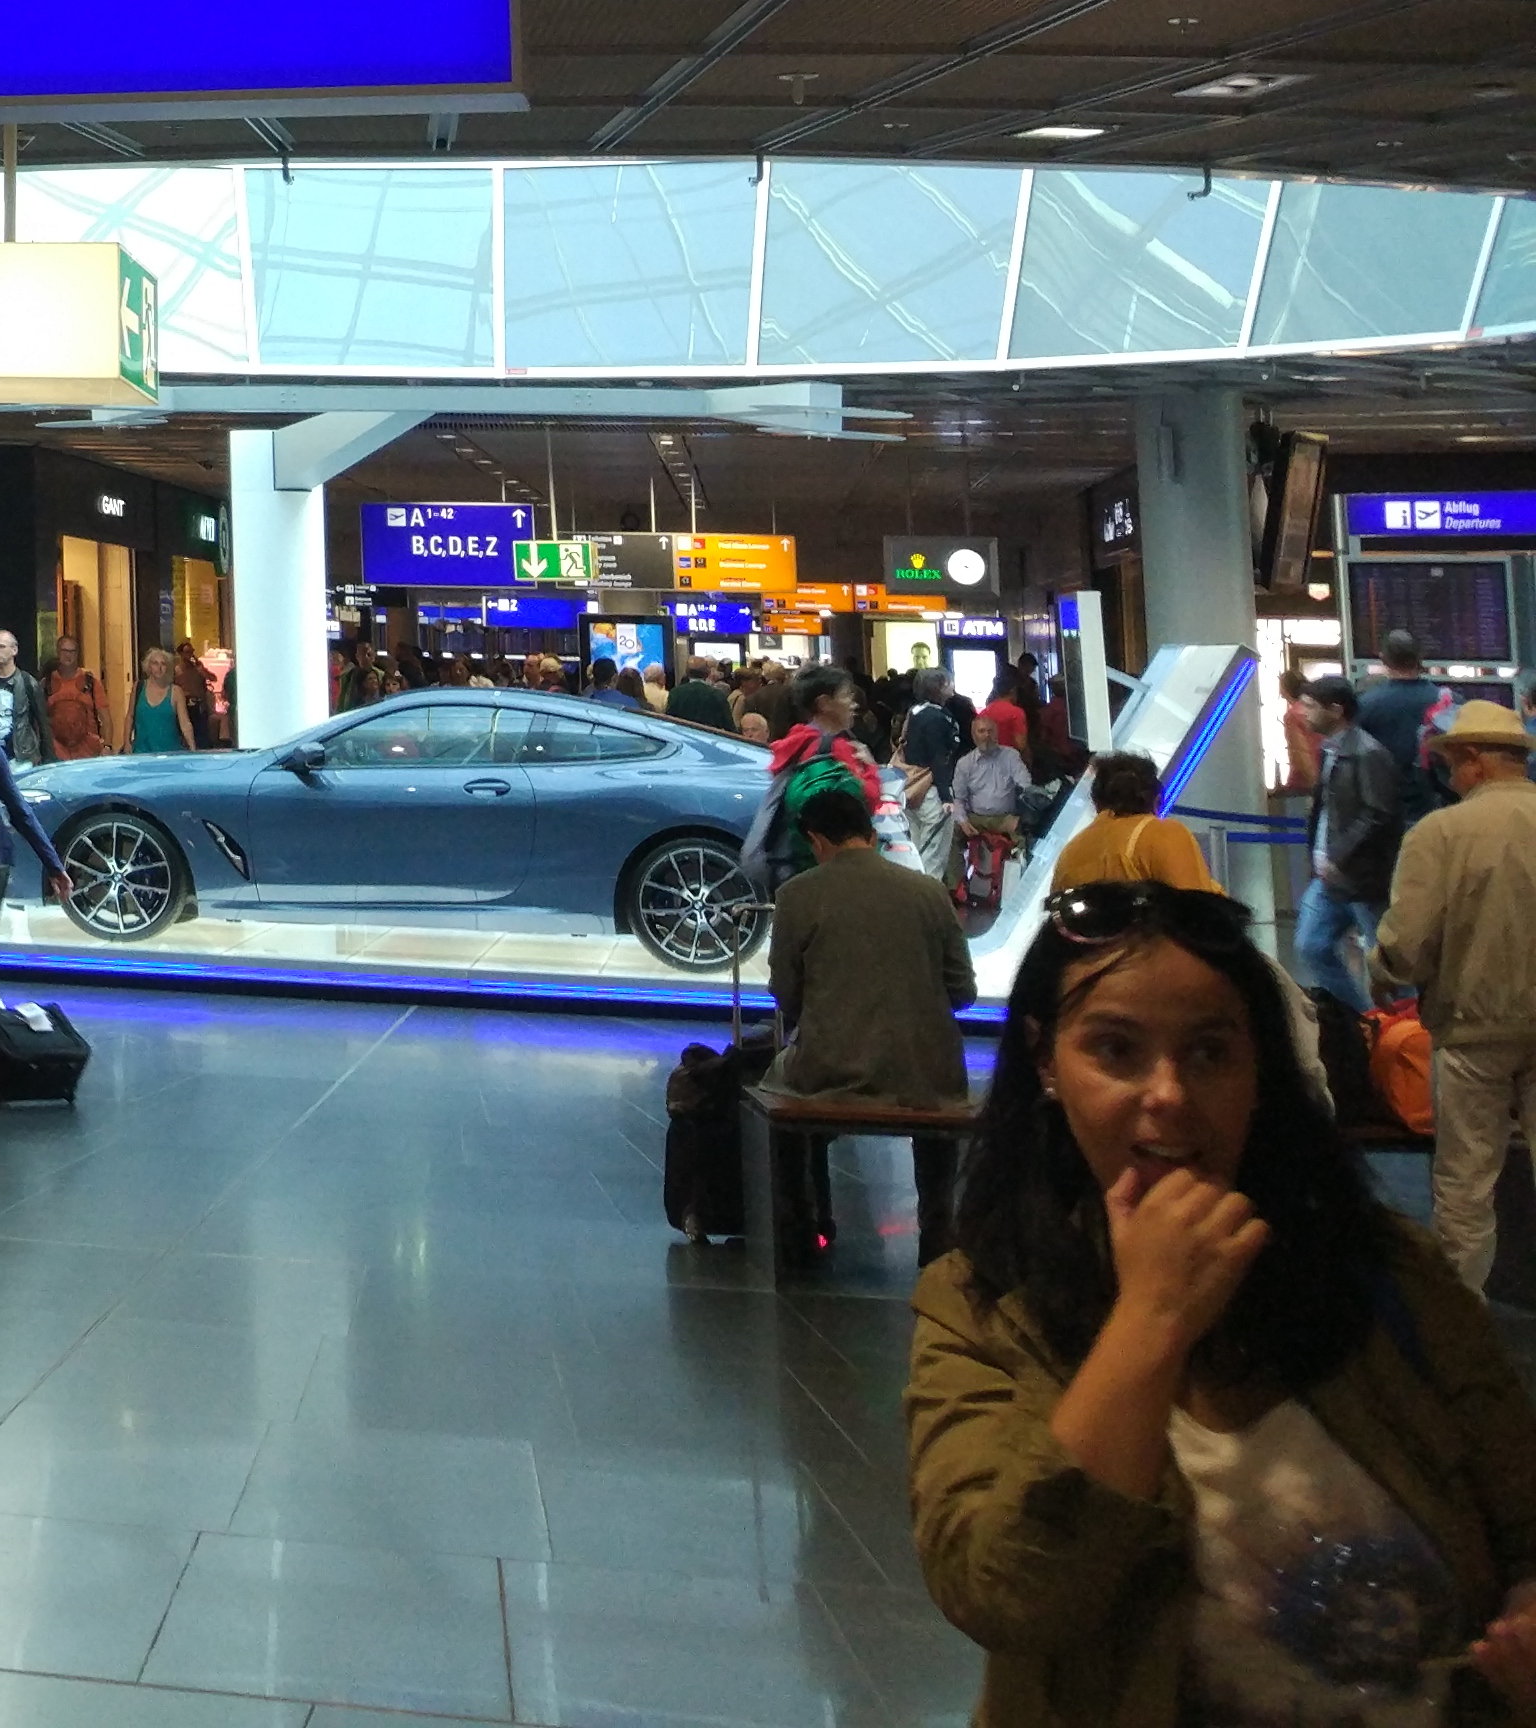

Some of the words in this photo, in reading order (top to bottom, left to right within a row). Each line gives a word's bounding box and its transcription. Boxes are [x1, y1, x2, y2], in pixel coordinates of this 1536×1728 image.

[101, 494, 127, 518] GANT
[1444, 500, 1480, 516] Abflug
[409, 507, 426, 528] A
[1445, 516, 1502, 532] Departures
[894, 568, 942, 580] ROLEX
[688, 603, 698, 616] A
[962, 620, 1005, 637] ATM
